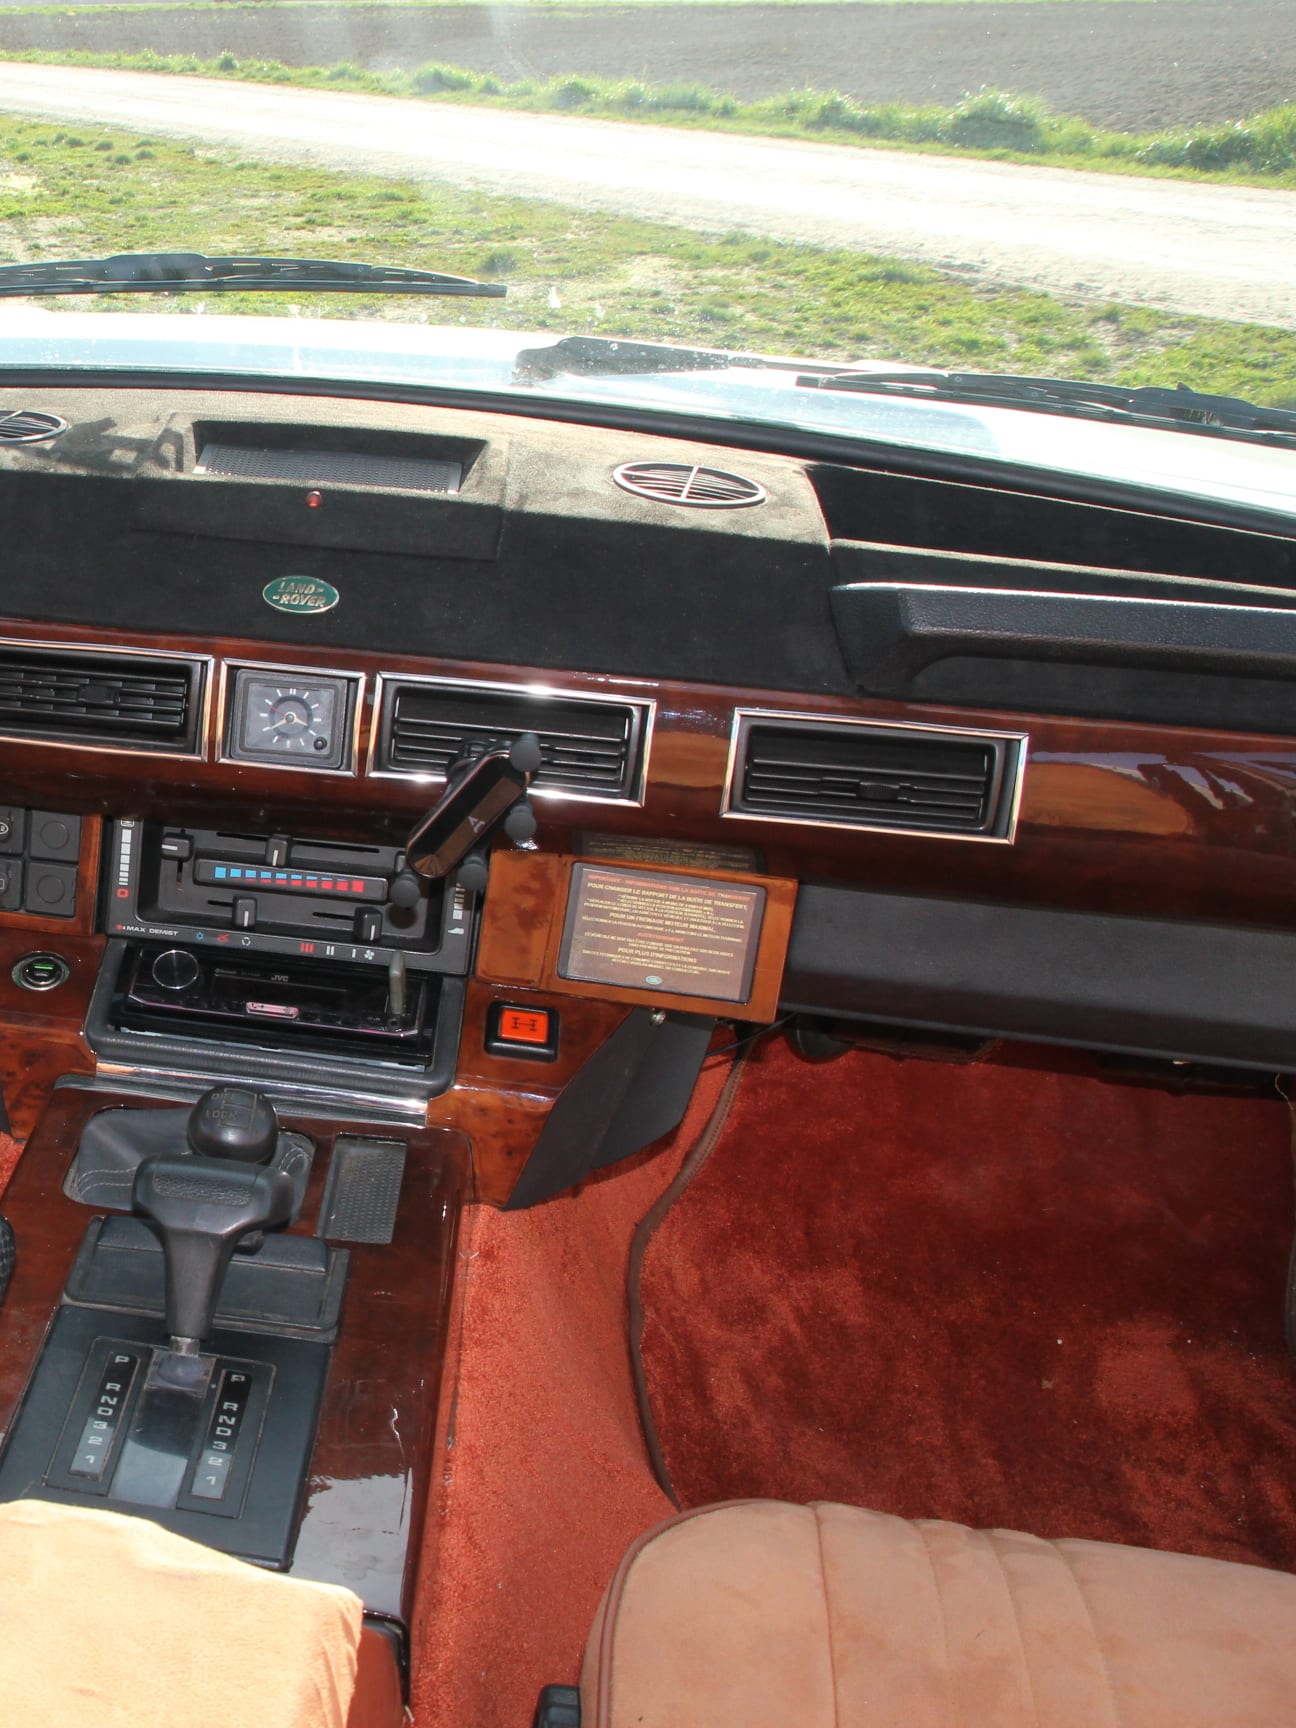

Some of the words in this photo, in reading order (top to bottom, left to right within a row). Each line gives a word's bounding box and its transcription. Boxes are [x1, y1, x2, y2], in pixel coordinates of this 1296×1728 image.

[126, 925, 146, 933] MAX
[149, 928, 179, 936] DEMIST
[271, 974, 290, 983] JVC
[105, 1382, 121, 1392] R
[100, 1395, 117, 1405] N
[223, 1402, 238, 1411] R
[97, 1407, 113, 1416] D
[218, 1415, 235, 1425] N
[93, 1421, 108, 1430] 3
[215, 1427, 232, 1437] D
[87, 1436, 103, 1445] 2
[212, 1441, 227, 1450] 3
[208, 1456, 223, 1466] 2
